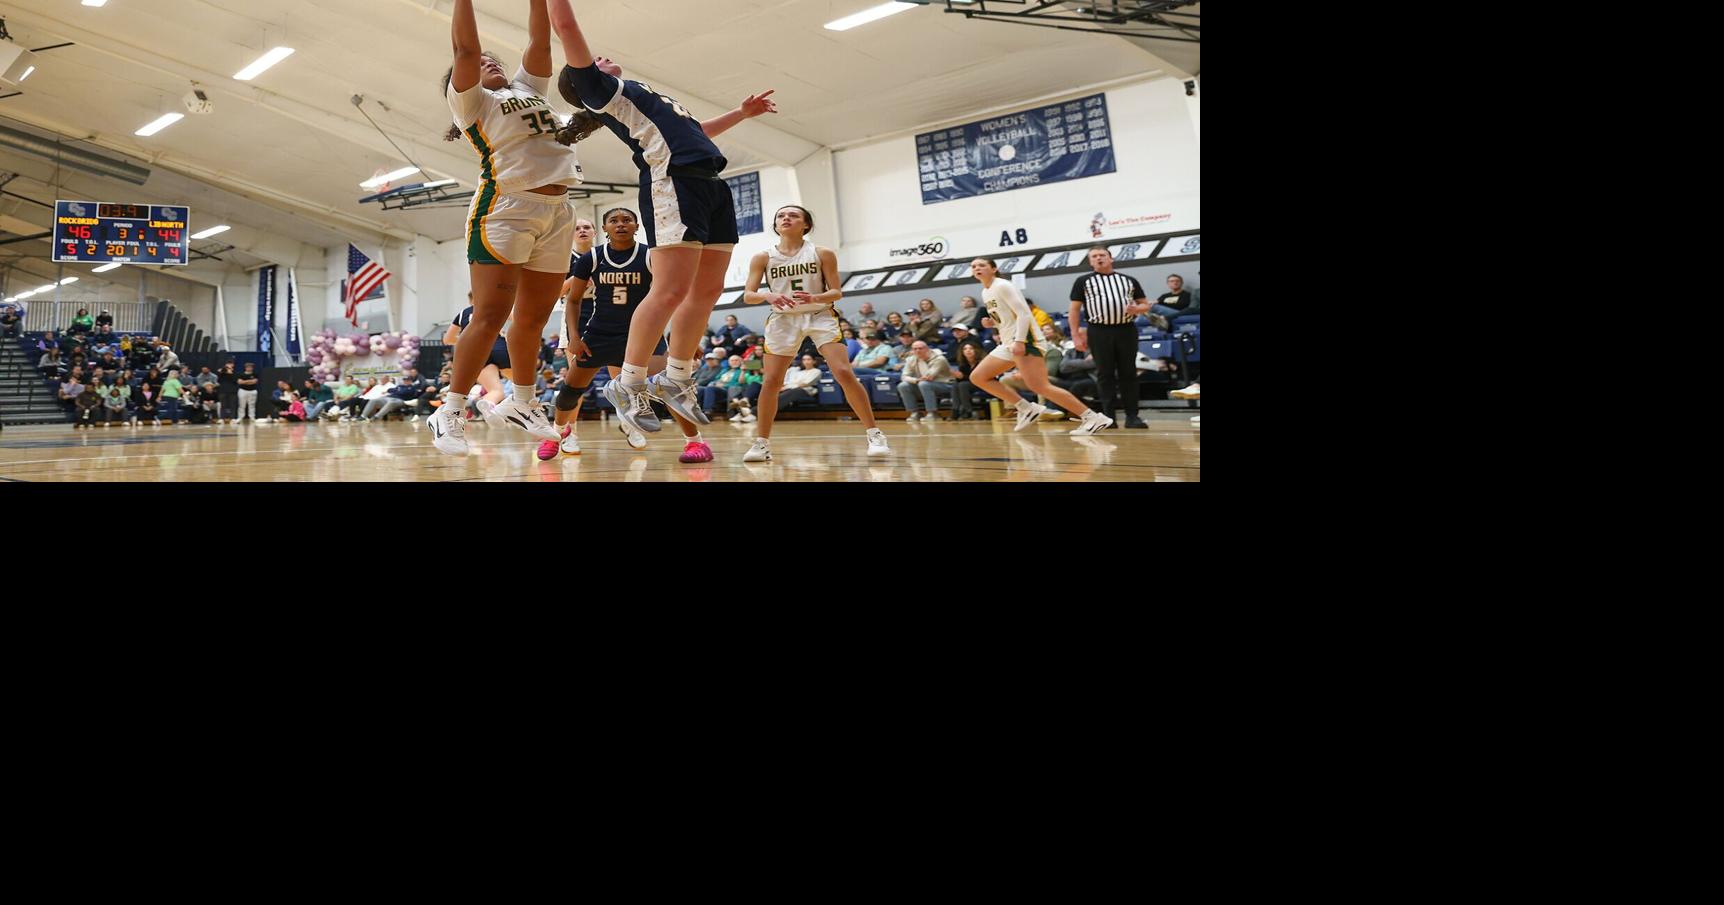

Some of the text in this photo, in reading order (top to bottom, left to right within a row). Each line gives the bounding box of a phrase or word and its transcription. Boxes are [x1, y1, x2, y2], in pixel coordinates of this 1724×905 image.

[521, 110, 557, 137] 35
[981, 114, 1025, 131] WOMEN'S
[976, 127, 1036, 145] VOLLEYBALL
[978, 160, 1042, 179] CONFERENCE
[984, 174, 1040, 191] CHAMPIONS
[68, 226, 91, 239] 46
[119, 228, 128, 239] 3
[158, 230, 180, 240] 44
[999, 228, 1028, 247] A8
[66, 244, 97, 255] 5 2
[106, 246, 125, 256] 20
[169, 248, 180, 257] 4
[889, 242, 943, 257] image360
[599, 271, 641, 285] NORTH
[770, 262, 818, 280] BRUINS
[265, 268, 273, 321] Leadership
[612, 286, 628, 305] 5
